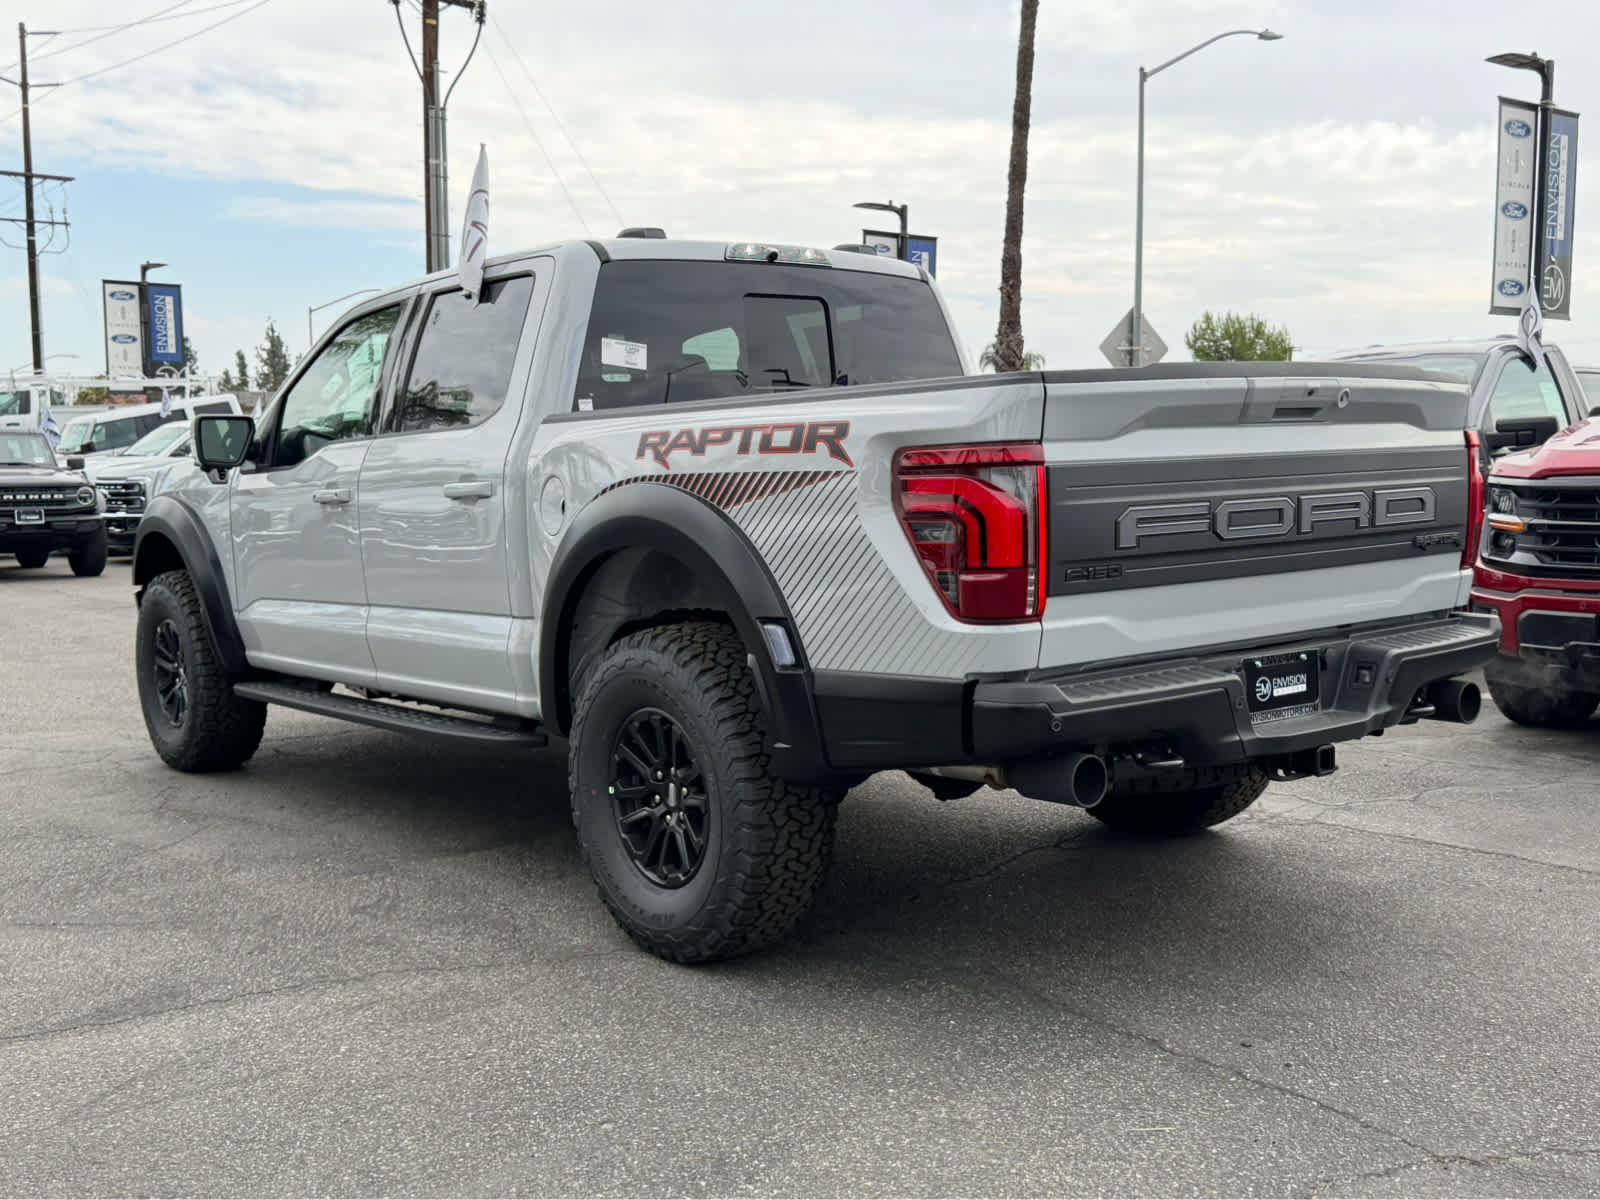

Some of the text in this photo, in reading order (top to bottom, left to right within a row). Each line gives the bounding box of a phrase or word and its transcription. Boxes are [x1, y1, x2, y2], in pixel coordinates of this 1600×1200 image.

[1545, 132, 1563, 240] ENVISION
[153, 294, 169, 353] ENVISION
[635, 420, 855, 471] RAPTOR
[1114, 486, 1438, 550] FORD
[1272, 673, 1307, 688] ENVISION
